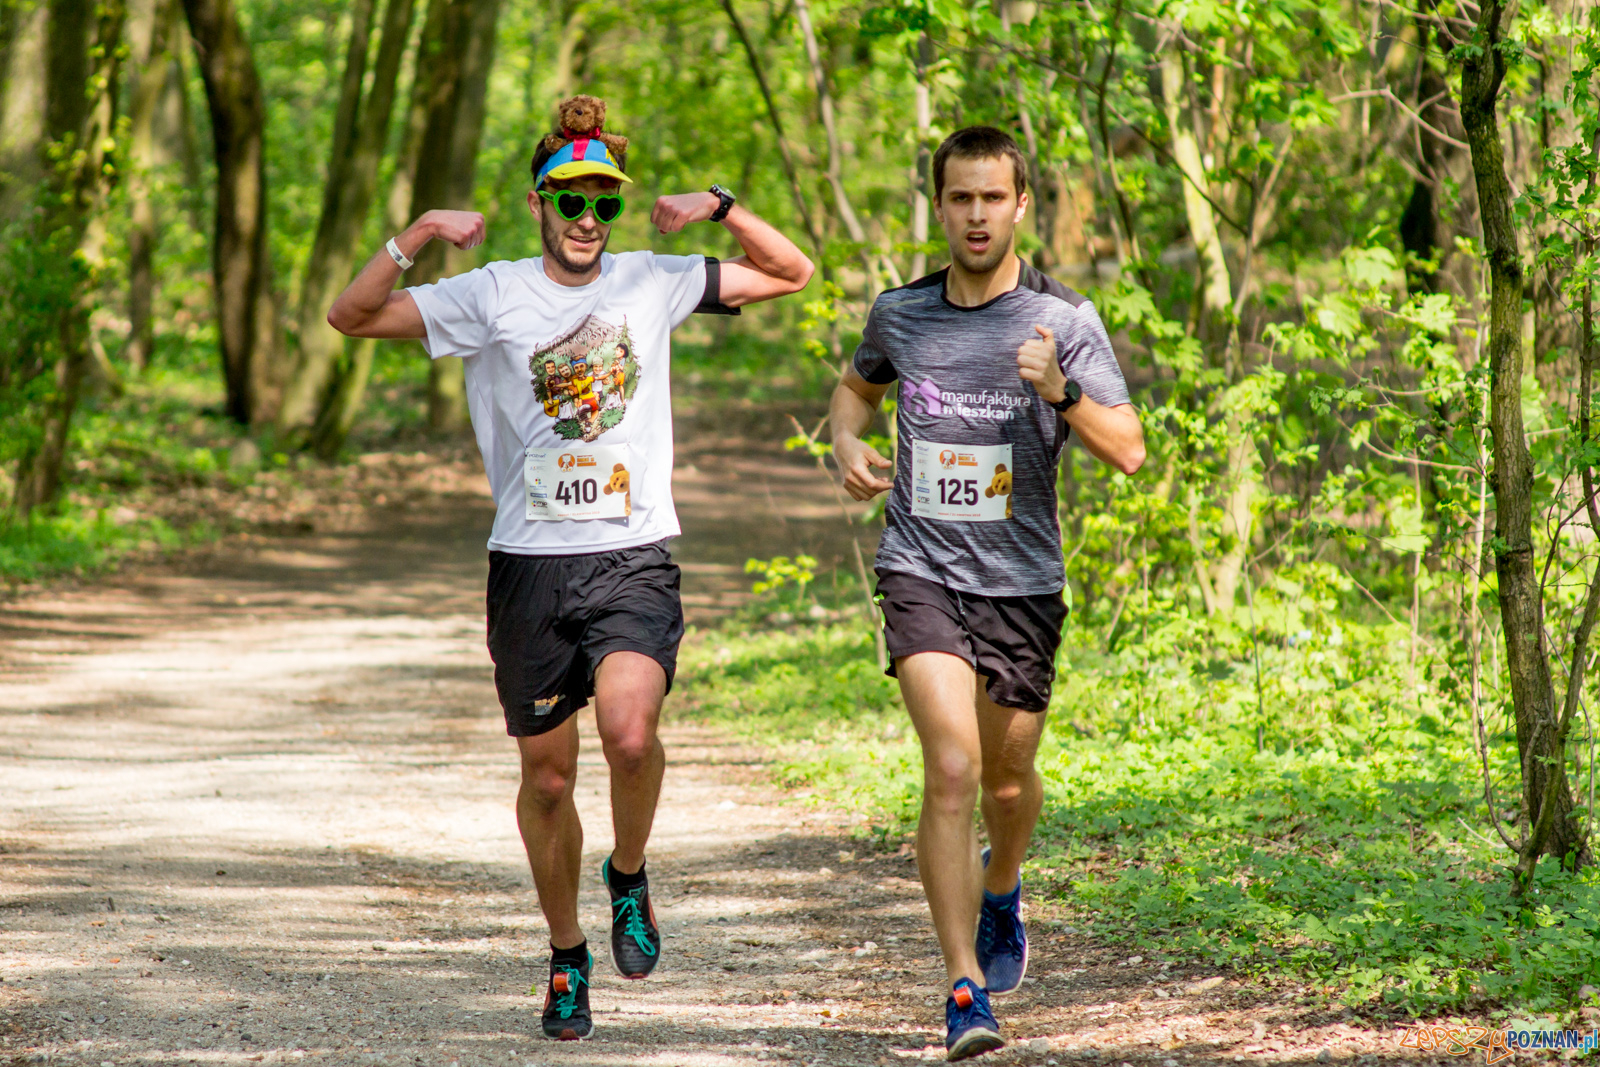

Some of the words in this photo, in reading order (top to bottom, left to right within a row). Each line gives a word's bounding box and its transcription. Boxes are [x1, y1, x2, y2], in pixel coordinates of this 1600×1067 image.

[941, 390, 1031, 407] manufaktura
[943, 403, 1015, 420] mieszkań
[555, 478, 597, 505] 410
[937, 478, 979, 506] 125
